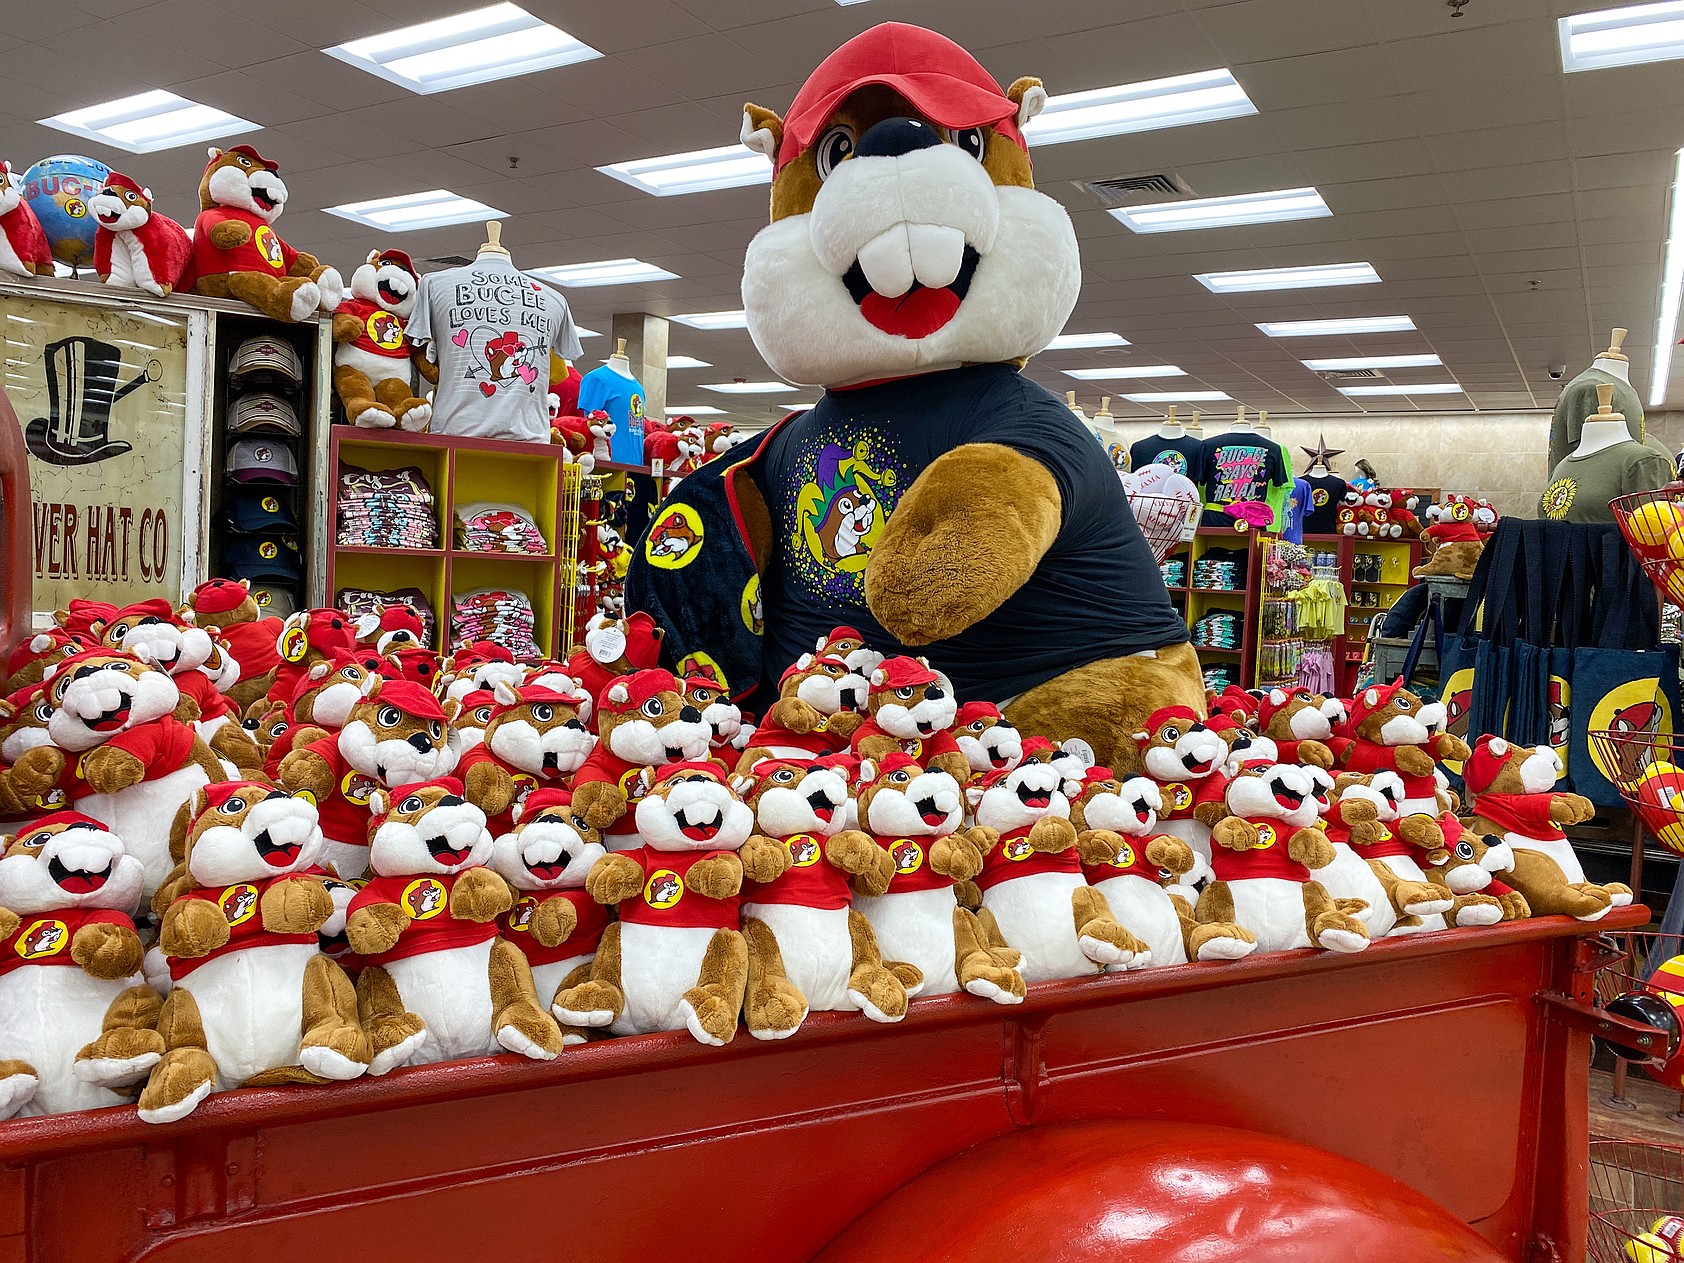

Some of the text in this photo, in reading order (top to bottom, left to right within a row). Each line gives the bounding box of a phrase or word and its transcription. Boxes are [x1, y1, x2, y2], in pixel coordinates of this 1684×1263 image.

[25, 176, 94, 201] BUC-
[471, 270, 531, 289] SOME
[455, 283, 546, 311] BUC-EE
[449, 306, 551, 337] LOVES ME!
[1217, 447, 1268, 467] BUC-EE
[1220, 464, 1256, 481] SAYS
[1213, 482, 1260, 502] RELAX
[33, 502, 169, 584] VER HAT CO
